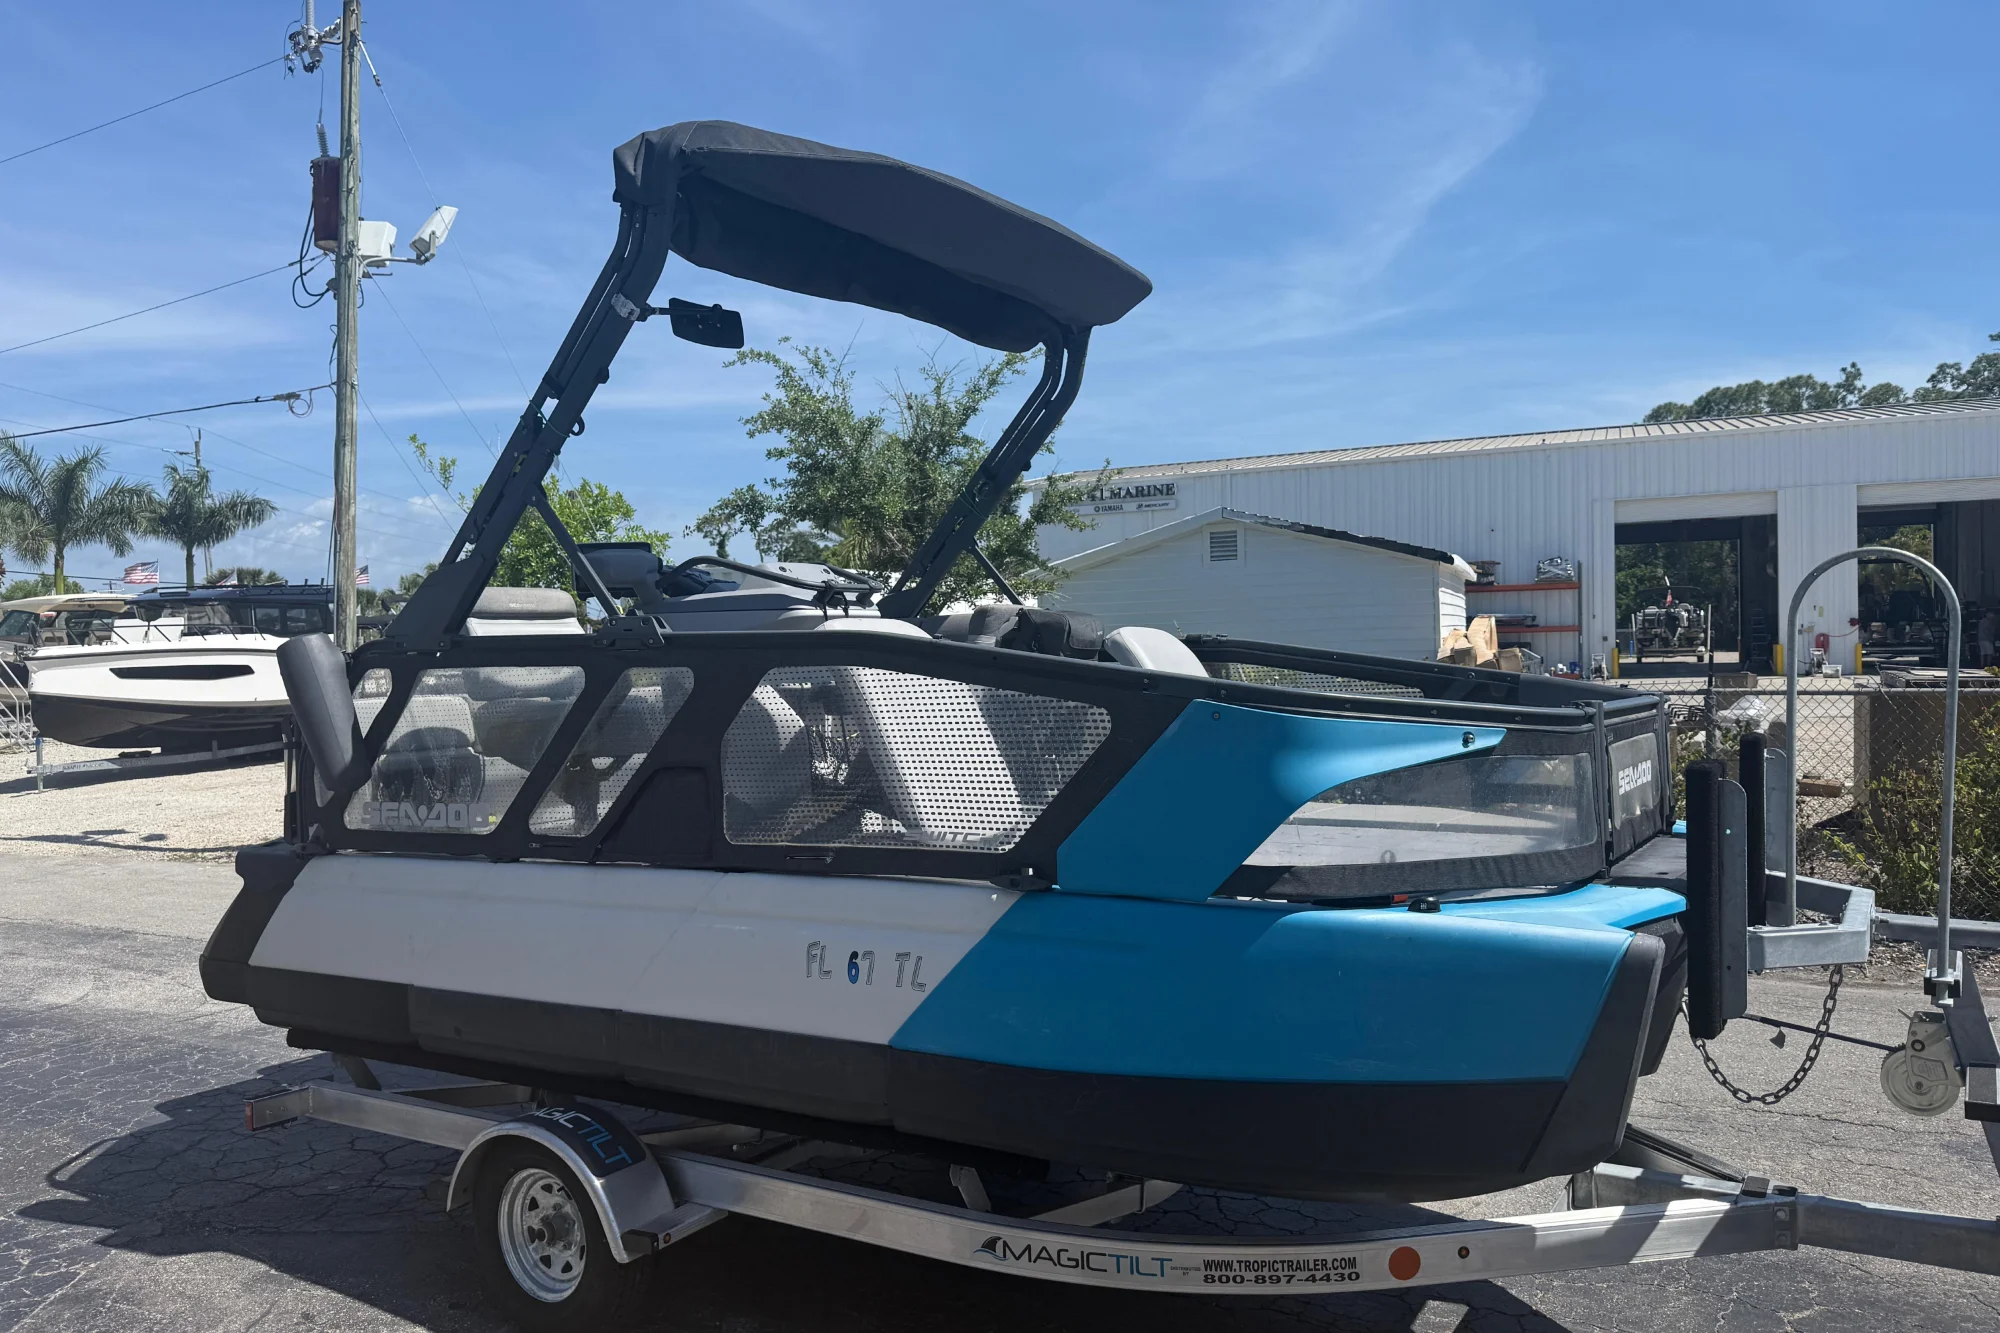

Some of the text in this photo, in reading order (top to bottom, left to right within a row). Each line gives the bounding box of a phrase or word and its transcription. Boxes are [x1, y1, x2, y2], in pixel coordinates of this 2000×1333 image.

[1109, 483, 1176, 500] MARINE
[1100, 504, 1124, 513] YAMAHA
[806, 941, 926, 992] FL 67 TL
[1002, 1239, 1173, 1278] MAGICTILT
[1203, 1257, 1357, 1273] WWW.TROPICTRAILER.COM
[1203, 1272, 1361, 1285] 800-897-4430
